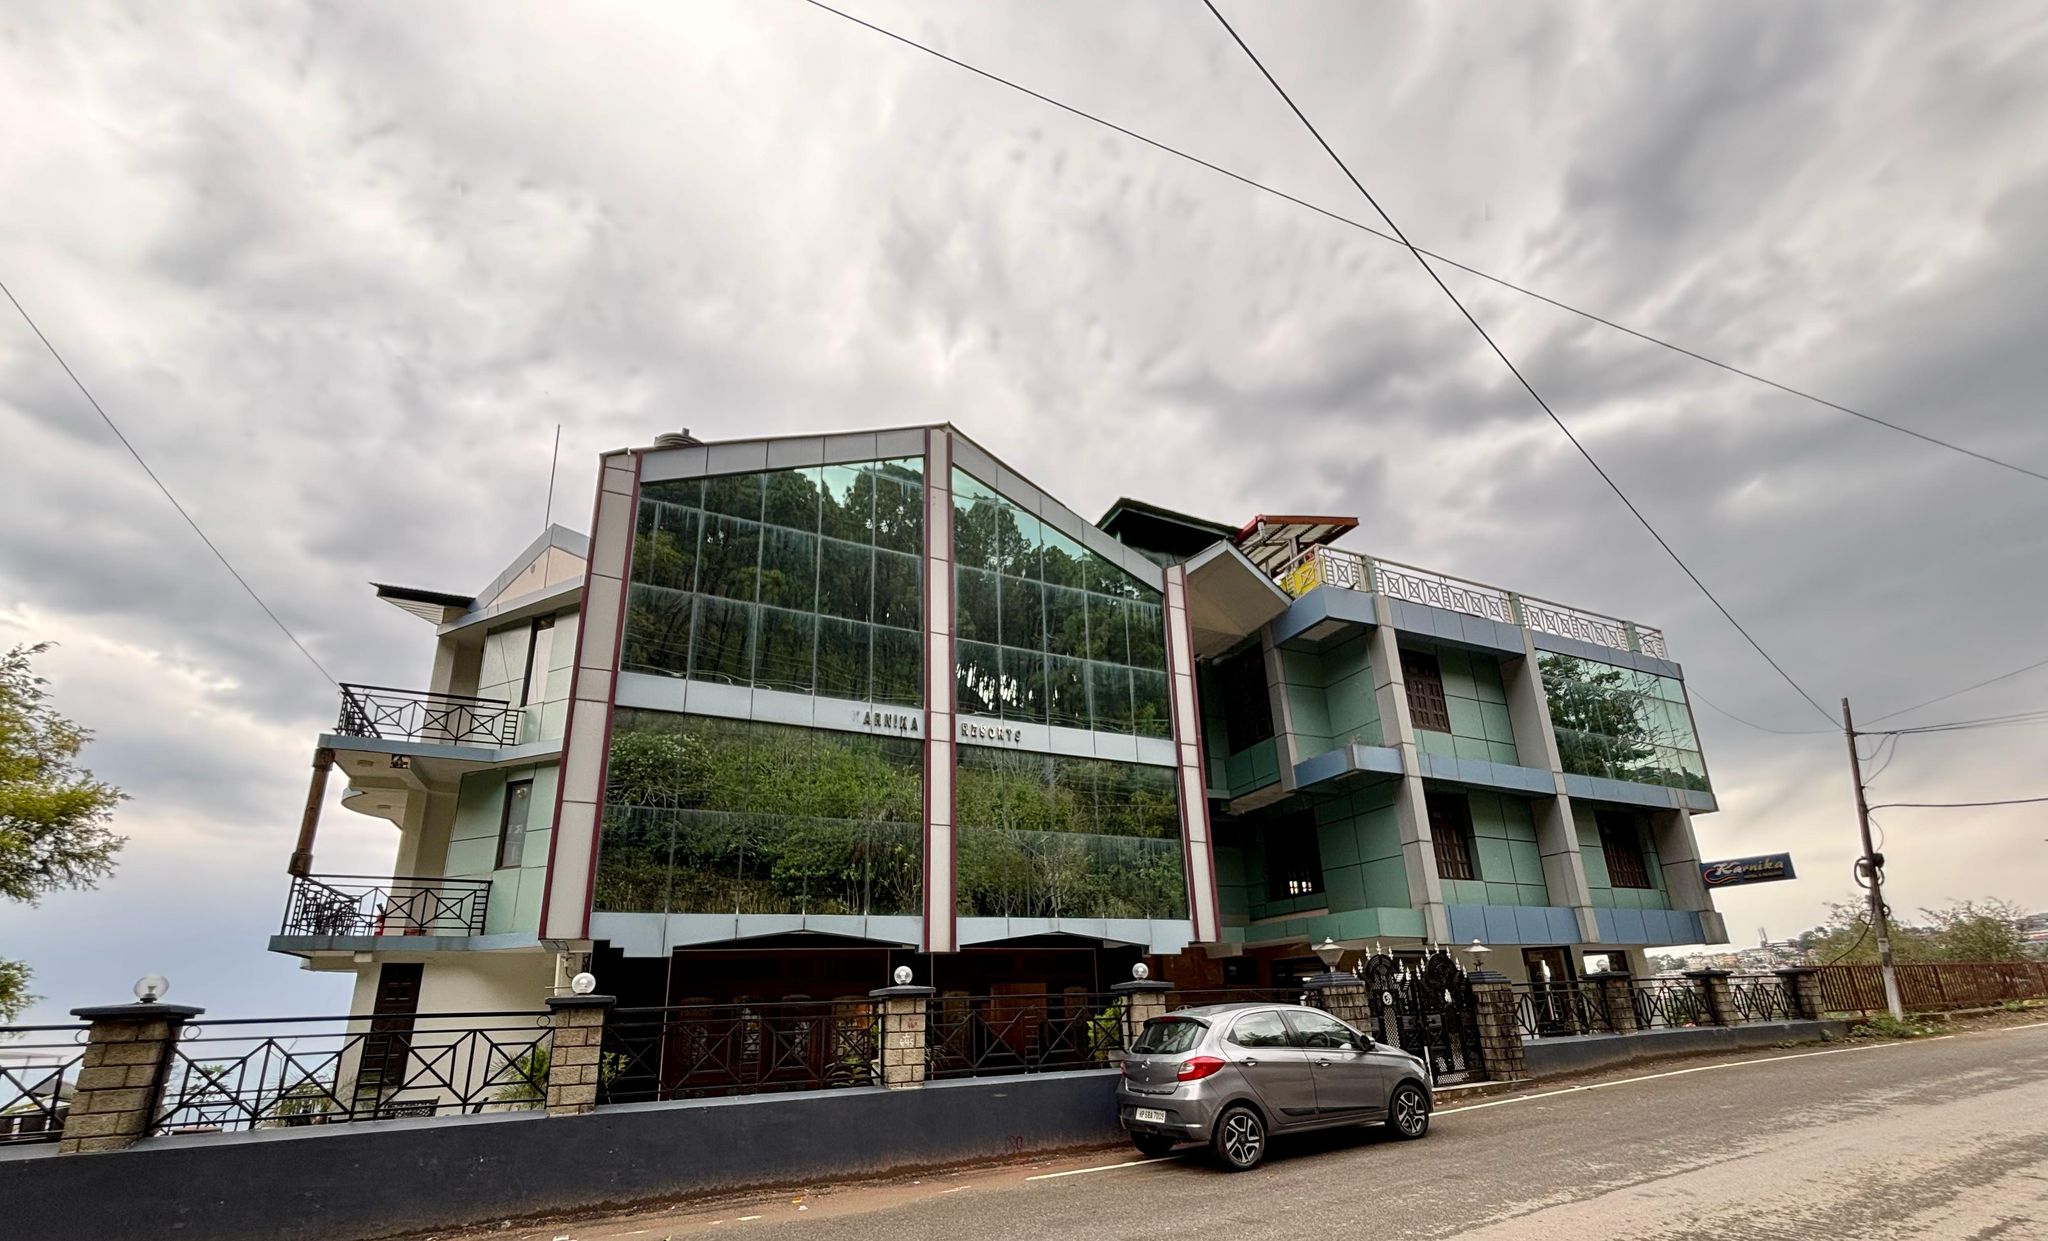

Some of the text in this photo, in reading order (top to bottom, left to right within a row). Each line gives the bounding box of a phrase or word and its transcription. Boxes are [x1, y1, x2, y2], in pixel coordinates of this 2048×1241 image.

[852, 709, 1021, 742] ARNIKA RESORTS
[1713, 858, 1784, 876] Karnika
